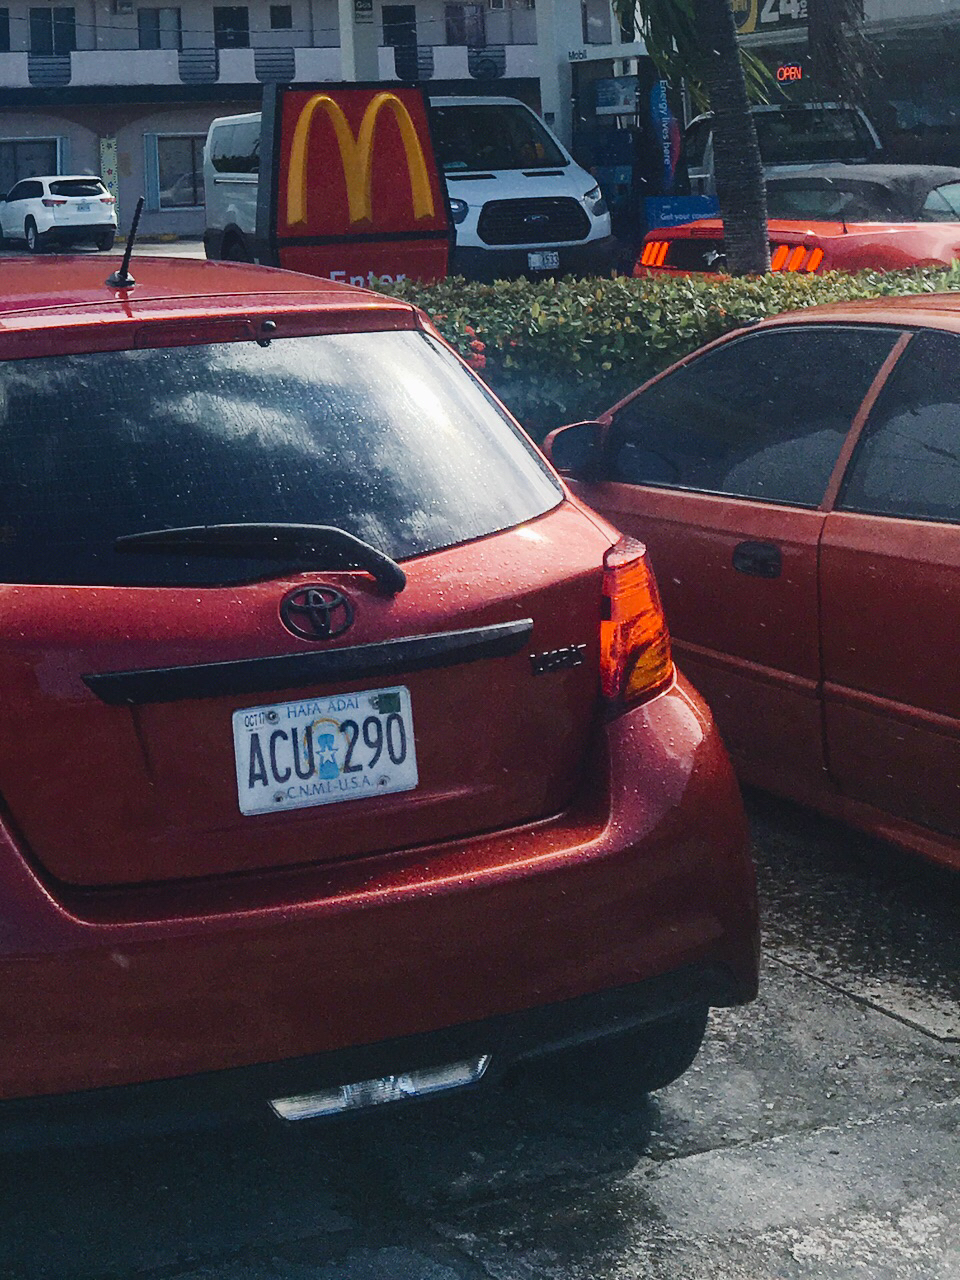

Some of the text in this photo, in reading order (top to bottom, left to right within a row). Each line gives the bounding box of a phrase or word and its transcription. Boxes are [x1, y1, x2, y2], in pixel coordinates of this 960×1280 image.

[568, 49, 588, 61] Mobil
[776, 66, 803, 81] OPEN
[659, 79, 671, 166] Energy lives here
[286, 697, 361, 719] HAFA ADAI
[248, 713, 407, 789] ACU 290
